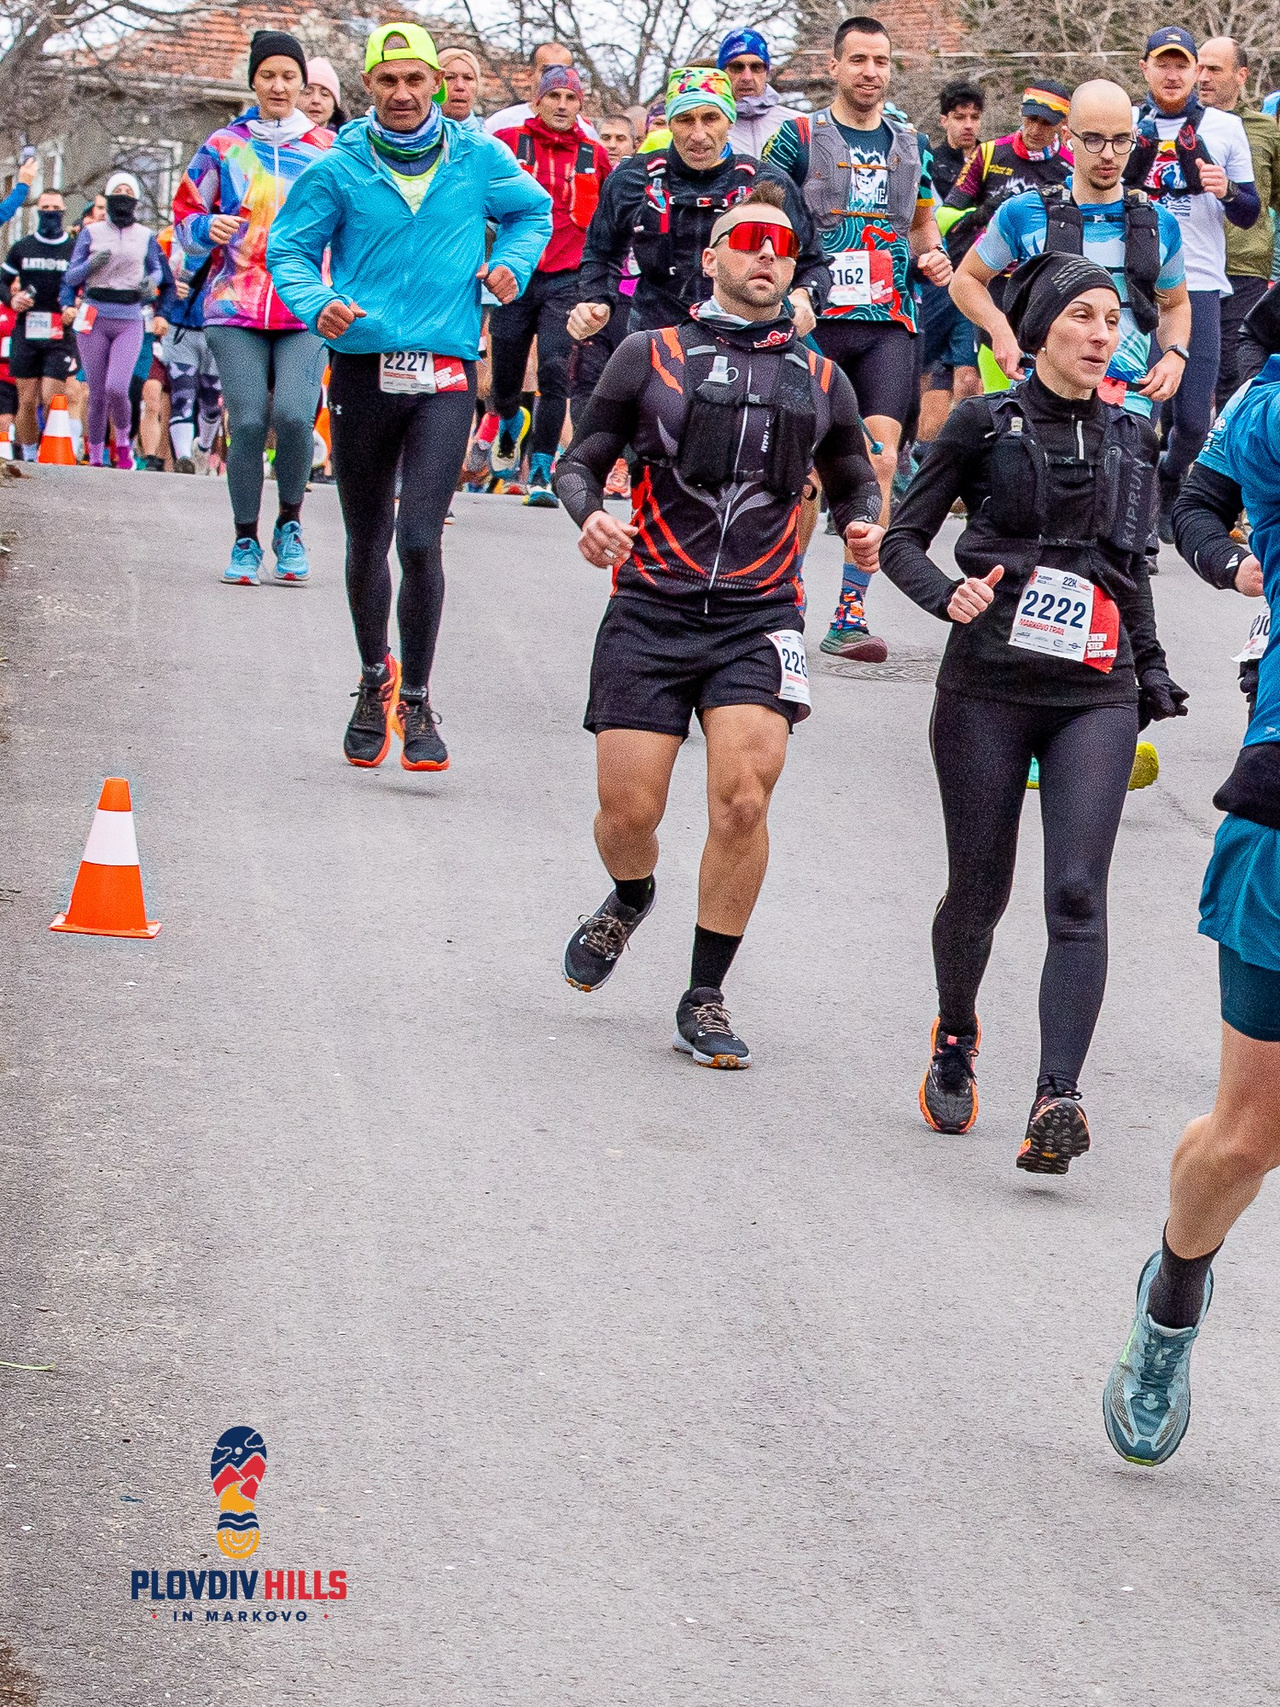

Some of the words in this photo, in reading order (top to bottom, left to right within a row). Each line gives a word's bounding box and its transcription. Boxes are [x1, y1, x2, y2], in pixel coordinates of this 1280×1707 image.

[384, 351, 428, 372] 2227
[1122, 457, 1147, 546] KIPRUN
[1021, 590, 1087, 629] 2222
